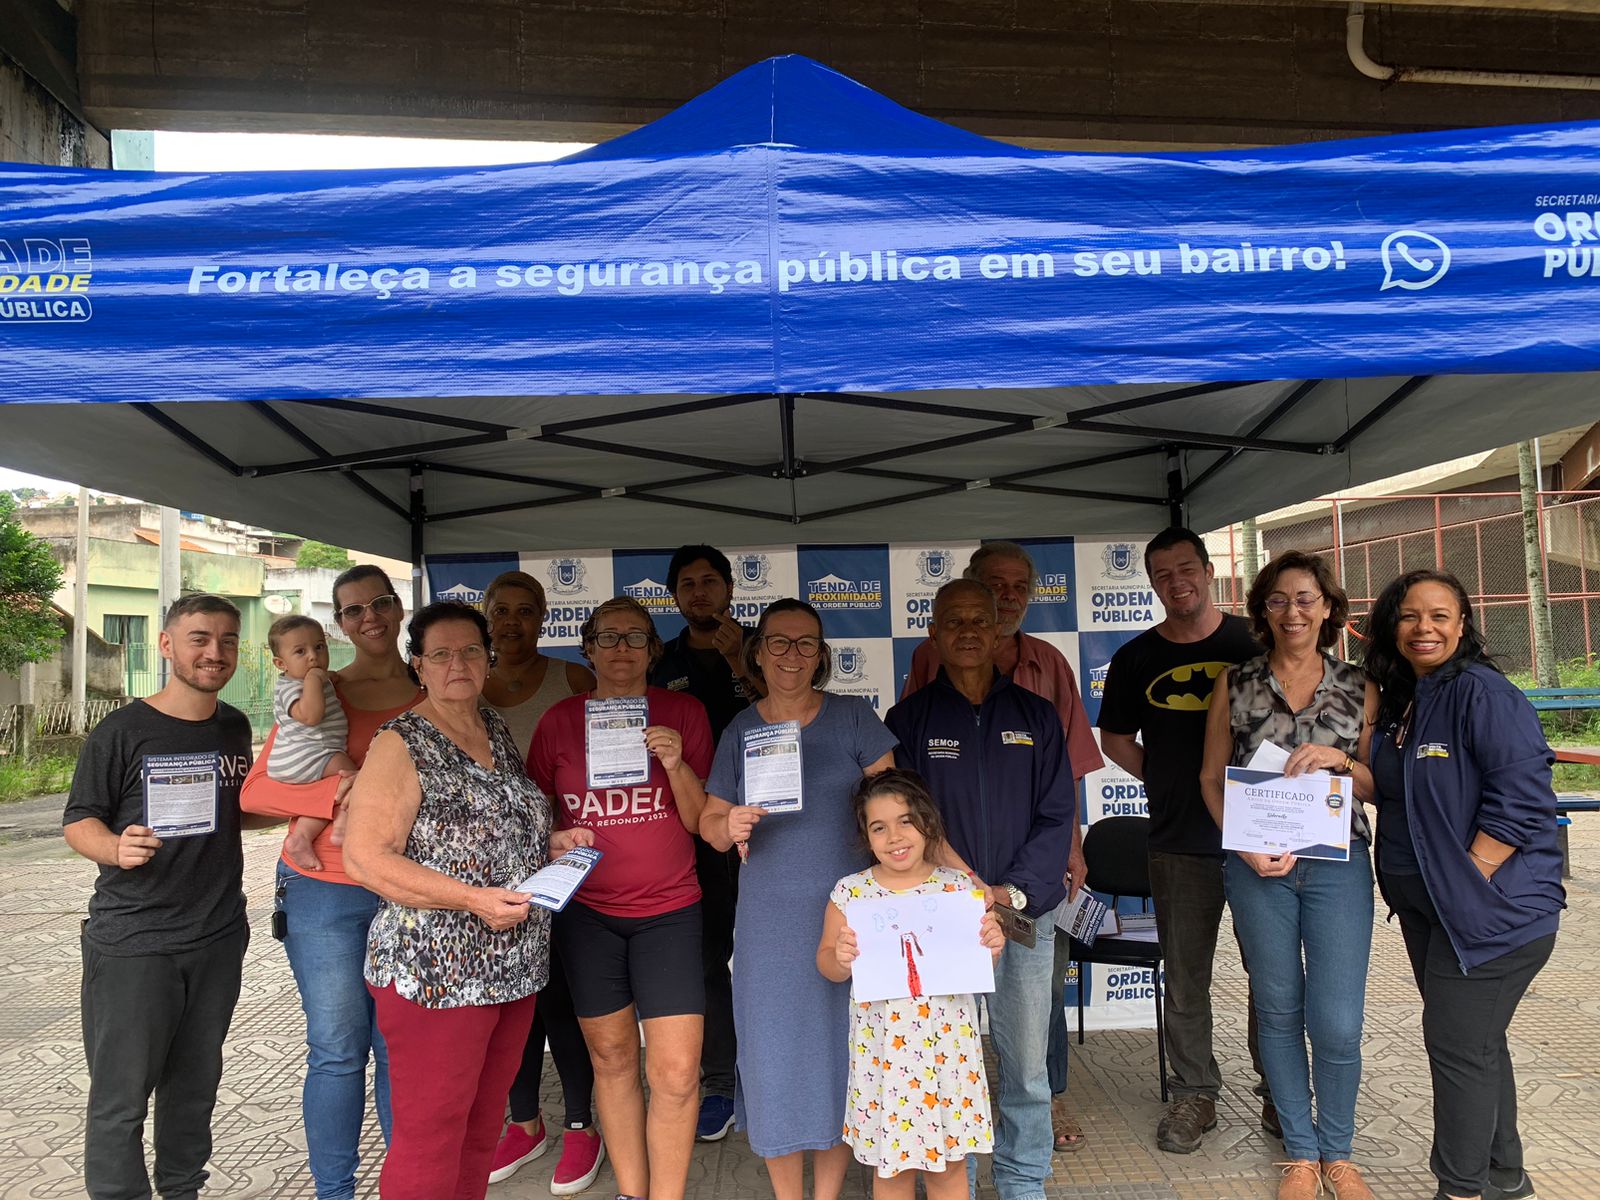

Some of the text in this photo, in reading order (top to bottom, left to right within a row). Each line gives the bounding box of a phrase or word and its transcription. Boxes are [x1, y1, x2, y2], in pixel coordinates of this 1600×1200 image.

[188, 240, 1347, 300] Fortaleça a segurança pública em seu bairro!
[0, 296, 86, 318] ÚBLICA
[808, 581, 881, 593] TENDA DE
[1046, 573, 1066, 586] DE
[808, 593, 882, 602] PROXIMIDADE
[850, 600, 881, 608] PÚBLICA
[1091, 591, 1154, 607] ORDEM
[1092, 605, 1154, 622] PÚBLICA
[928, 738, 960, 748] SEMOP
[147, 758, 217, 768] SEGURANÇA PÚBLICA
[174, 754, 207, 762] INTEGRADO
[1101, 784, 1147, 800] ORDE
[1244, 787, 1315, 802] CERTIFICADO
[563, 787, 666, 819] PADEL
[596, 816, 646, 827] REDONDA
[648, 812, 668, 822] 2022
